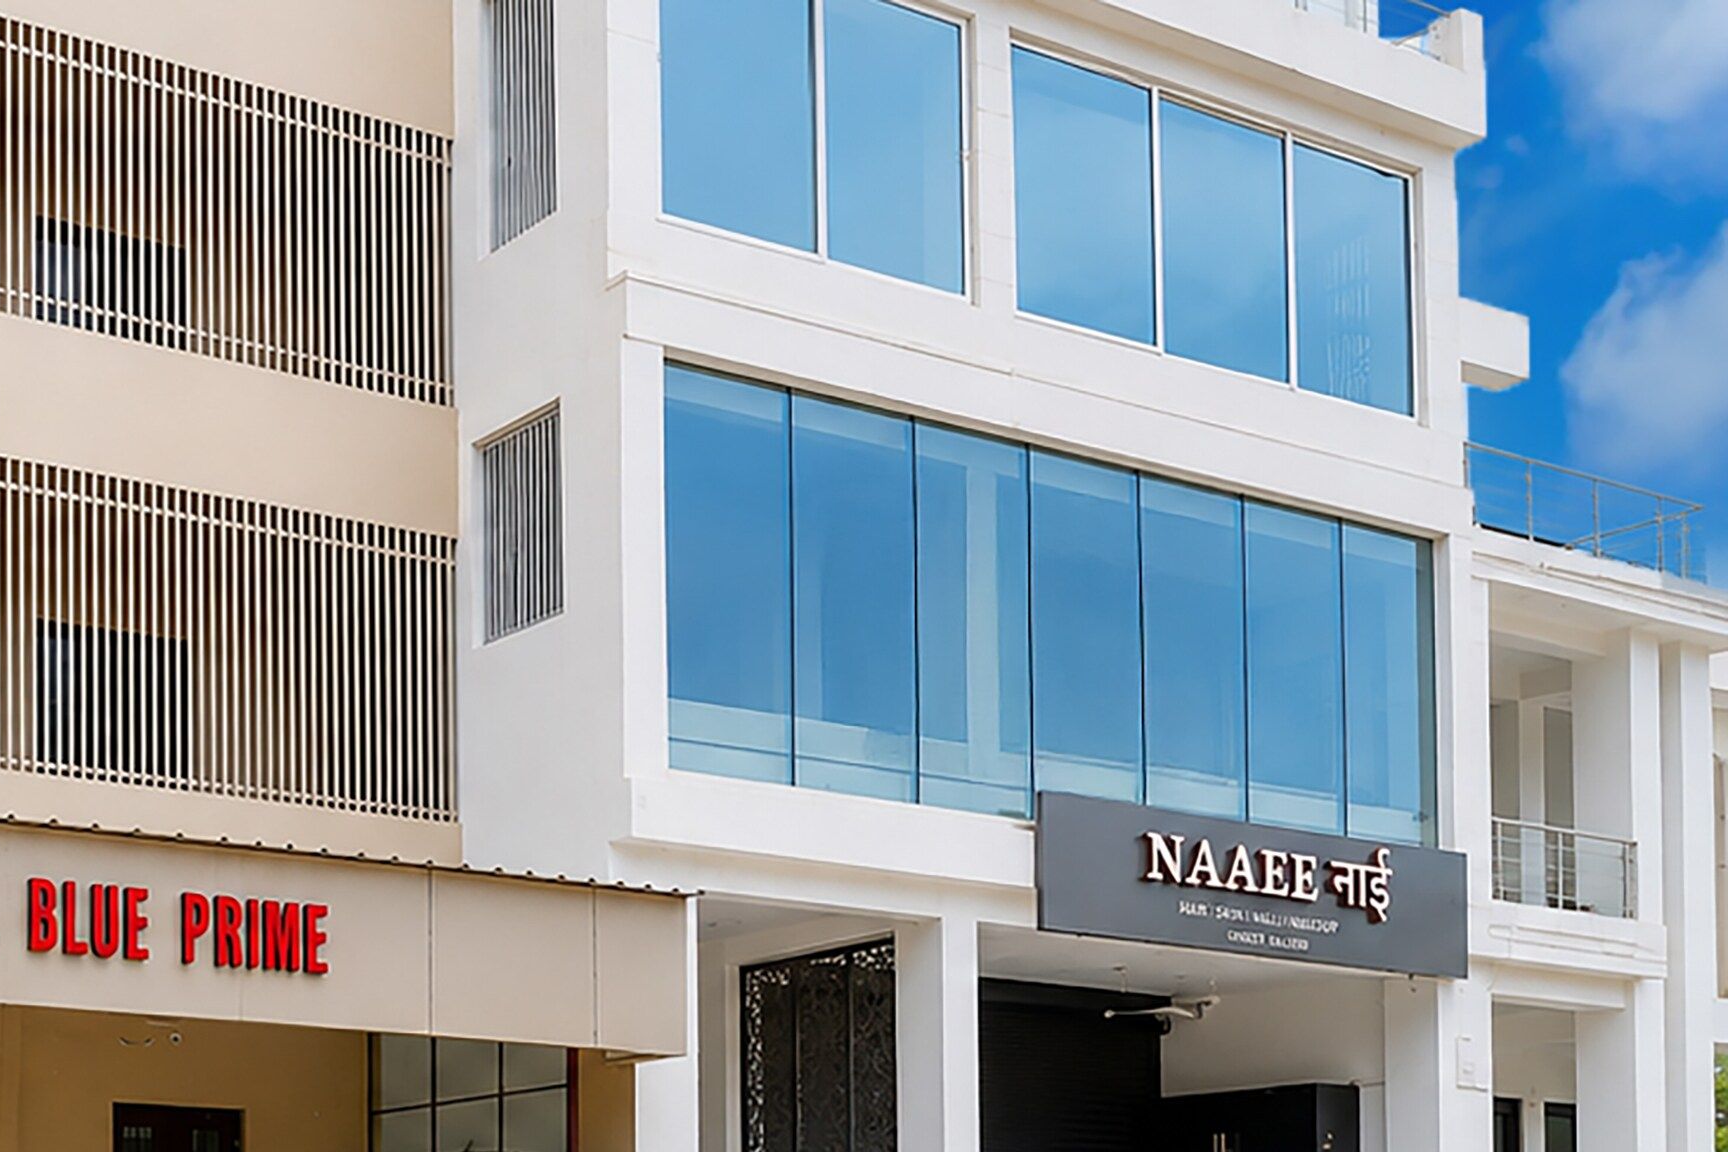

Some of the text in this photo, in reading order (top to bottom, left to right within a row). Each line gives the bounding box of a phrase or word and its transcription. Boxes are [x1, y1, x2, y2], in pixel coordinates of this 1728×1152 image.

[1143, 831, 1320, 902] NAAEE
[1329, 848, 1393, 922] नाई
[27, 877, 150, 961] BLUE
[180, 891, 329, 975] PRIME
